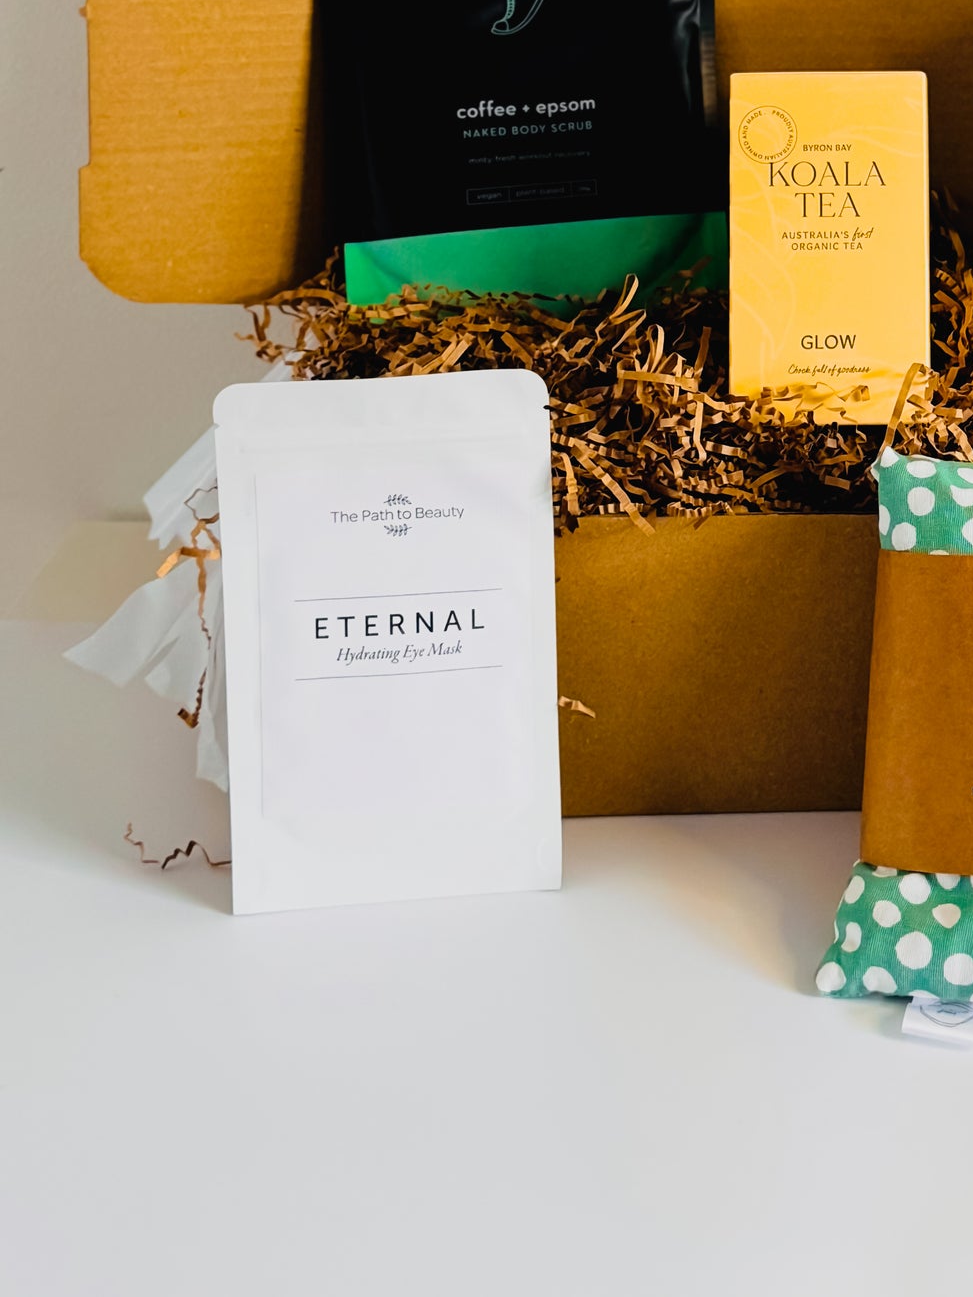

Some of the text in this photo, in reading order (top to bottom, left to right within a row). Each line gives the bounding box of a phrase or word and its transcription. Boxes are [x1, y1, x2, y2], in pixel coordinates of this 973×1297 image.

[456, 99, 597, 119] coffee + epsom
[746, 110, 762, 124] MADE
[463, 120, 593, 139] NAKED BODY SCRUB
[771, 110, 794, 133] PROUDLY
[743, 140, 763, 160] OWNED
[764, 134, 794, 161] AUSTRALIAN
[802, 144, 852, 152] BYRON BAY
[768, 161, 887, 187] KOALA
[794, 192, 861, 218] TEA
[781, 227, 874, 241] AUSTRALIA'S first
[791, 242, 863, 251] ORGANIC TEA
[800, 334, 857, 350] GLOW
[788, 363, 871, 377] Chock full of goodness
[330, 506, 465, 524] The Path to Beauty
[314, 608, 486, 640] ETERNAL
[336, 639, 463, 666] Hydrating Eye Mask
